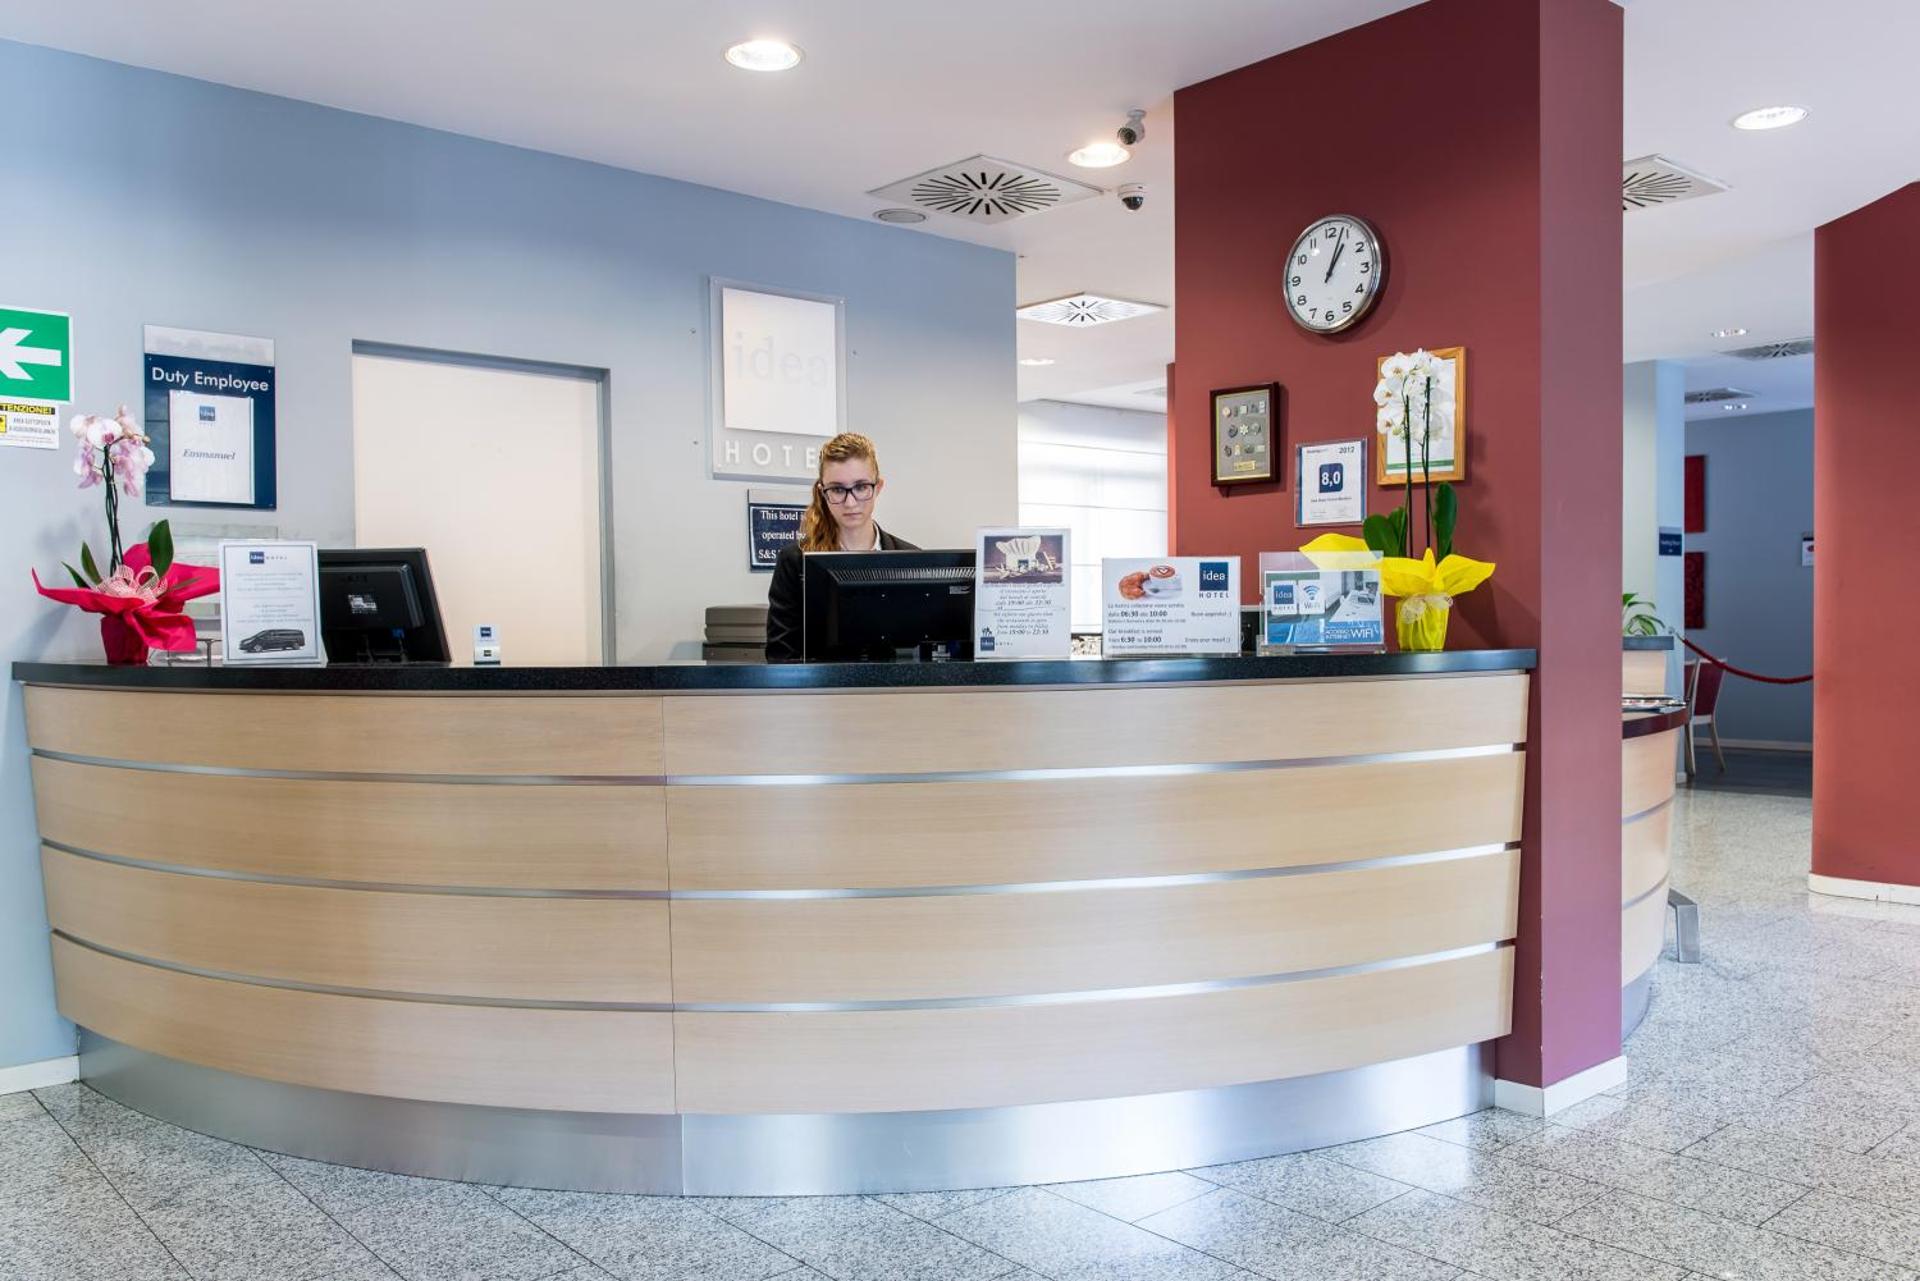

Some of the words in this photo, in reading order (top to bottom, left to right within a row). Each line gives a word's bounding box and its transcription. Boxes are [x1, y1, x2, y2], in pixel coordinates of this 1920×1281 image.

[1325, 227, 1337, 239] 12
[1310, 238, 1317, 249] 11
[1355, 242, 1365, 253] 2
[1297, 254, 1308, 265] 10
[1360, 262, 1370, 273] 3
[1291, 276, 1301, 287] 9
[1355, 283, 1364, 293] 4
[1297, 295, 1307, 306] 8
[1342, 301, 1353, 313] 5
[1309, 308, 1318, 319] 7
[1325, 311, 1335, 321] 6
[732, 330, 829, 387] idea
[152, 366, 190, 387] Duty
[194, 371, 270, 393] Employee
[724, 440, 818, 469] HOTE
[1321, 472, 1341, 487] 8,0
[760, 510, 778, 520] This
[779, 511, 799, 520] hotel
[762, 530, 795, 541] operated
[758, 548, 777, 559] S&S
[1202, 569, 1226, 581] idea
[1275, 590, 1293, 599] idea
